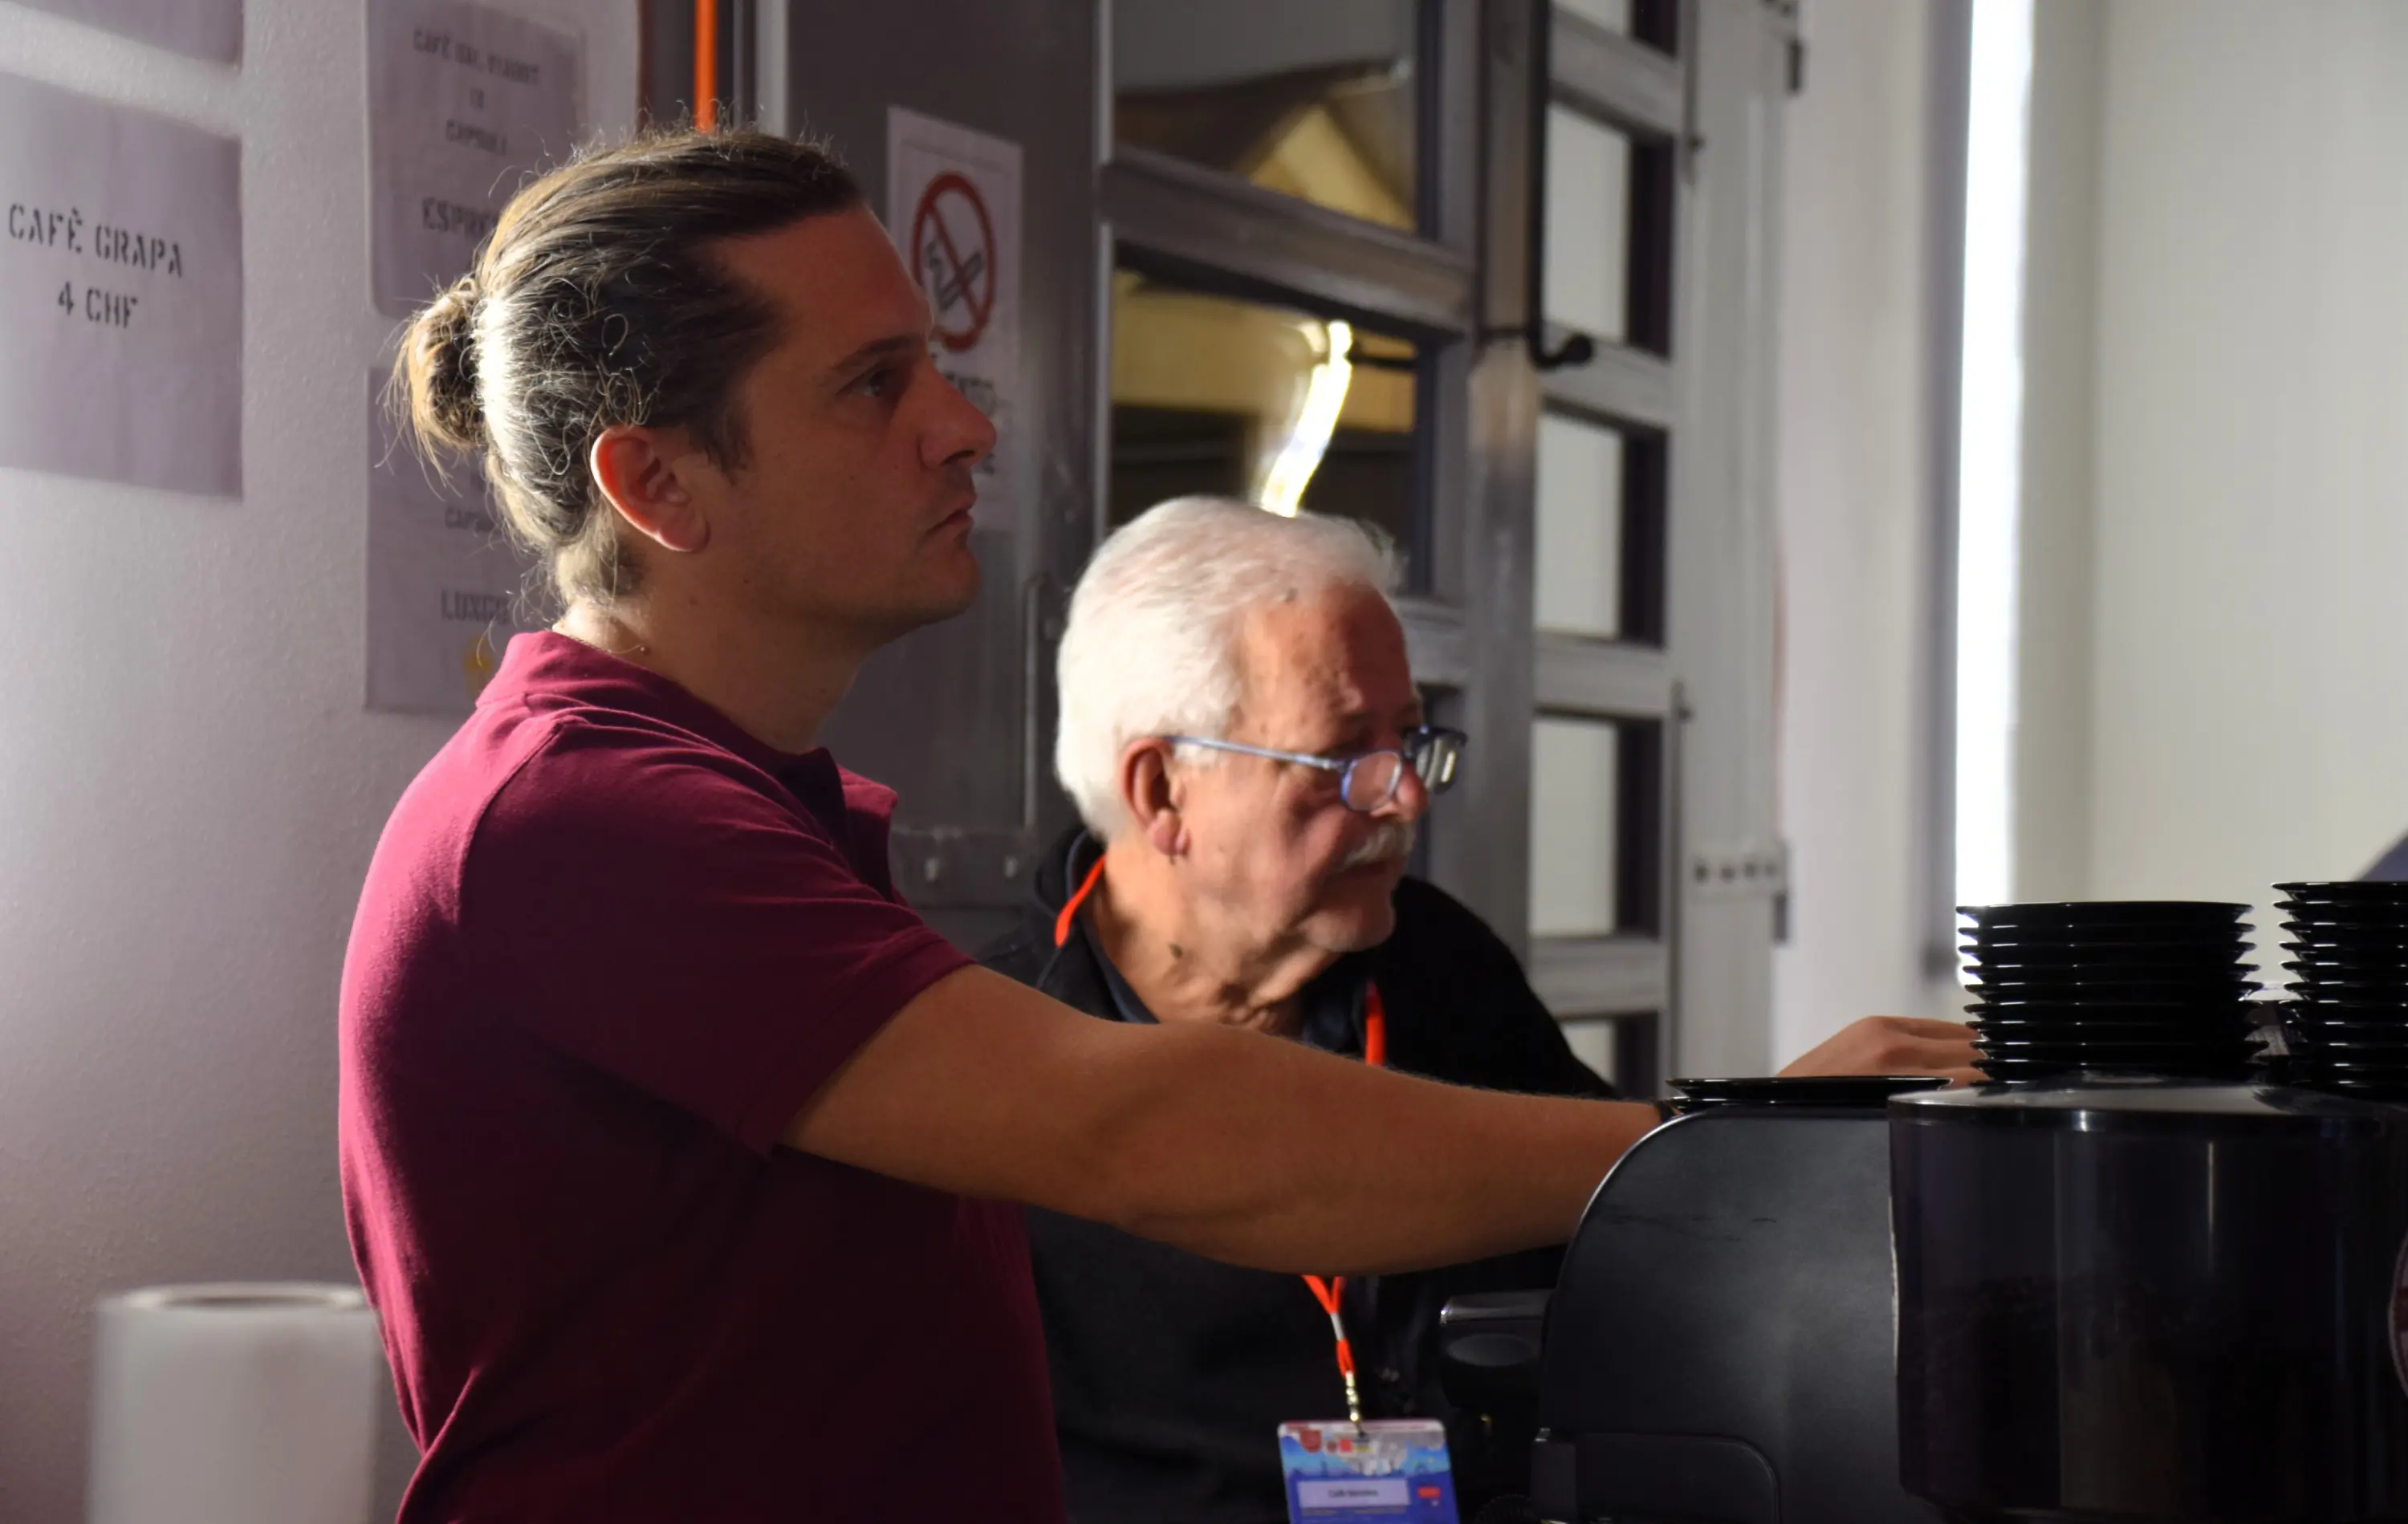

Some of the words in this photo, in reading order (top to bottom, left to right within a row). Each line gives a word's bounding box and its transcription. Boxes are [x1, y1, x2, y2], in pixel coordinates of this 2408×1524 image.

[10, 203, 83, 254] CAFÈ
[95, 224, 183, 278] GRAPA
[58, 282, 74, 315] 4
[86, 287, 138, 329] CHF
